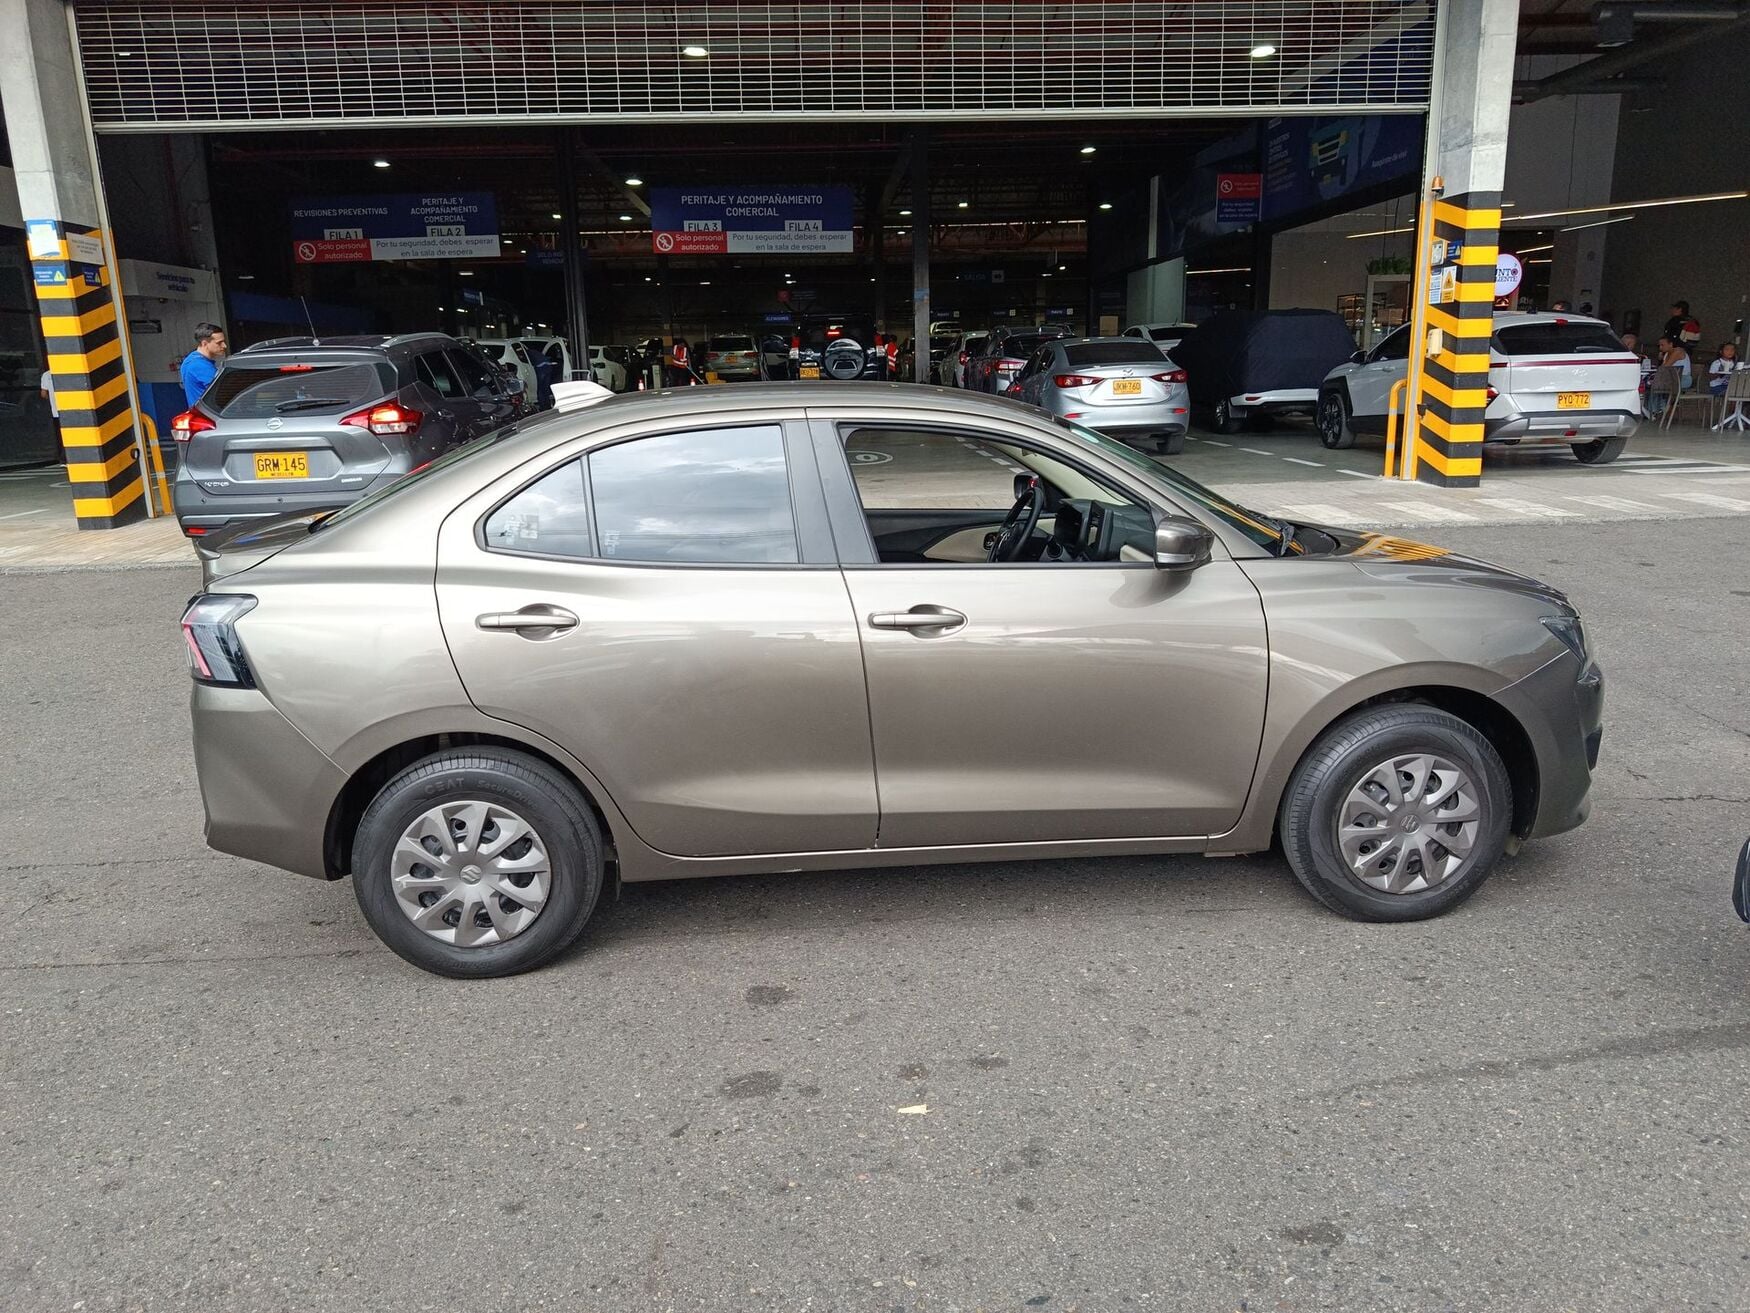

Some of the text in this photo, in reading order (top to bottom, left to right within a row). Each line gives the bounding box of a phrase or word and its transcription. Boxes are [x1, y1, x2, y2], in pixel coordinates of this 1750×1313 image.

[422, 198, 458, 206] PERITAJE
[681, 193, 823, 205] PERITAJE Y ACOMPAÑAMIENTO
[294, 207, 389, 218] REVISIONES PREVENTIVAS
[410, 205, 479, 215] ACOMPAÑAMIENTO
[726, 207, 780, 217] COMERCIAL
[424, 215, 467, 223] COMERCIAL
[688, 222, 718, 232] FILA 3
[789, 222, 819, 231] FILA 4
[329, 231, 352, 240] FILA
[431, 228, 461, 237] FILA 2
[439, 238, 463, 246] debes
[465, 239, 493, 247] esperar
[693, 234, 724, 242] personal
[820, 234, 847, 242] esperar
[335, 242, 368, 251] personal
[681, 243, 719, 251] autorizado
[775, 243, 789, 251] sala
[790, 243, 800, 251] de
[801, 244, 827, 252] espera
[325, 251, 363, 260] autorizado
[448, 250, 473, 258] espera
[424, 777, 465, 794] CEAT
